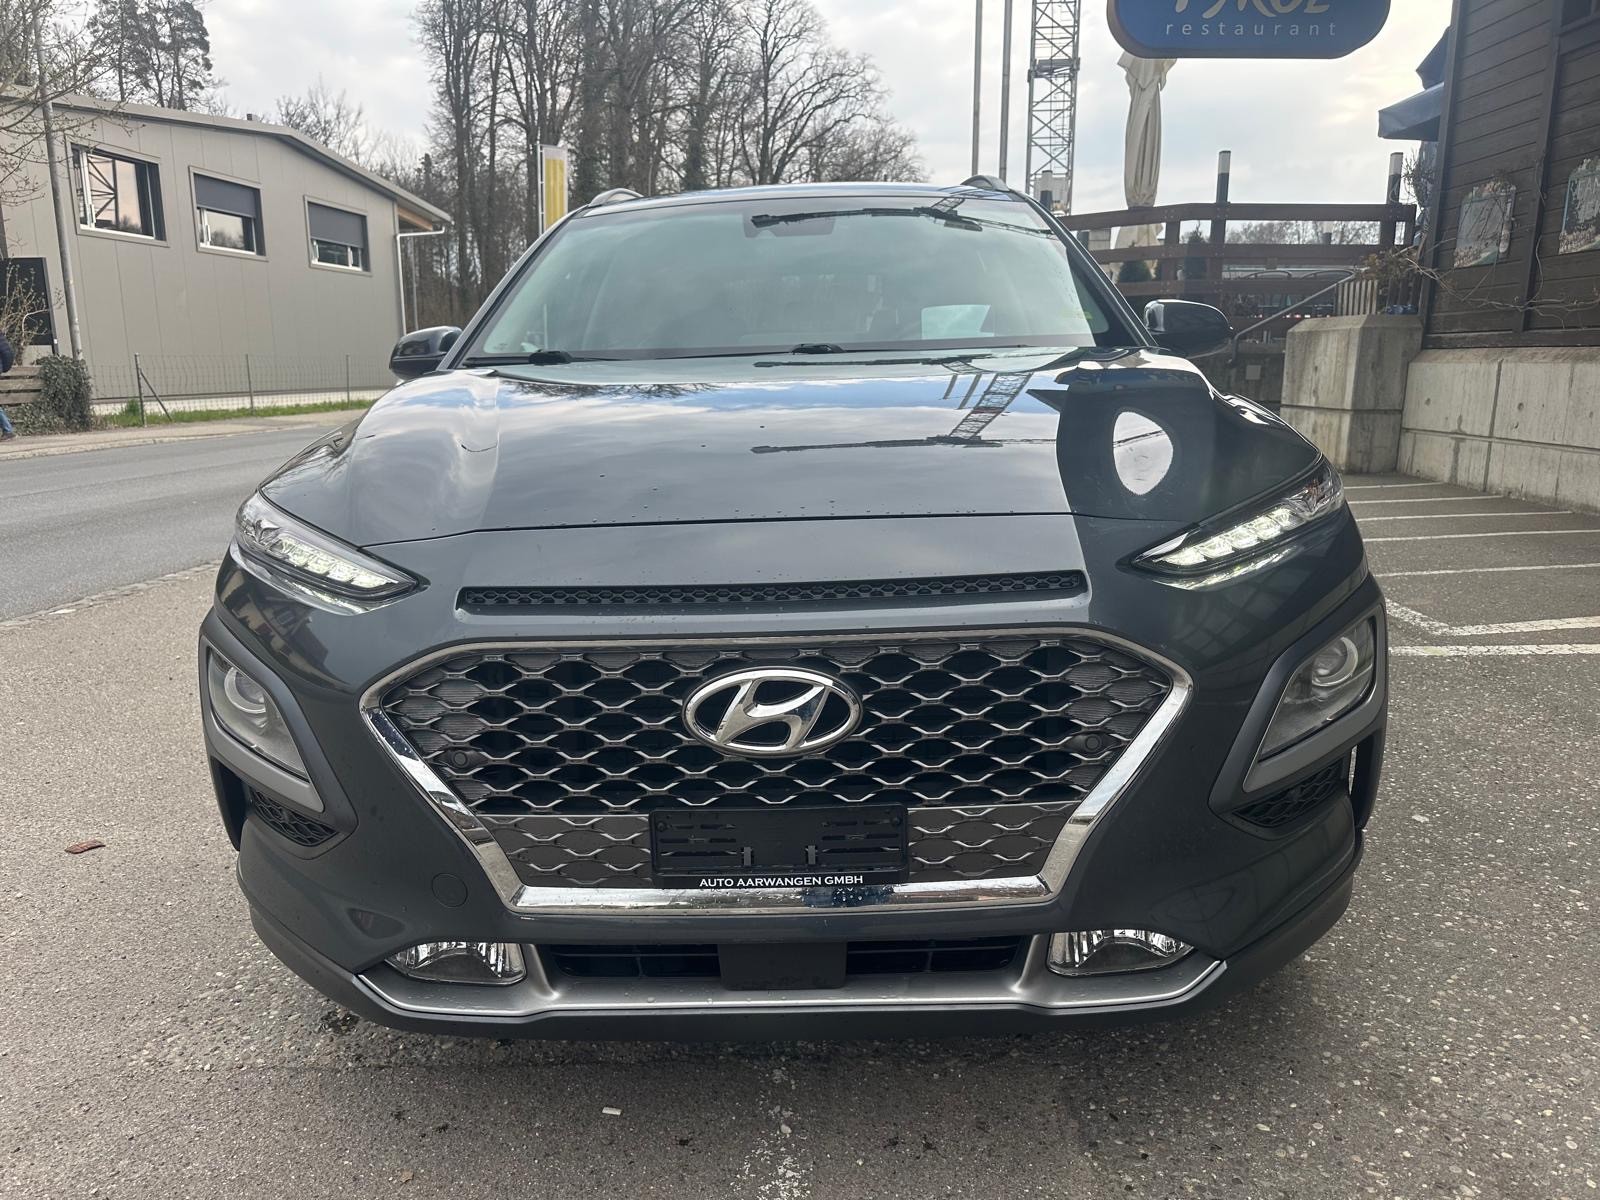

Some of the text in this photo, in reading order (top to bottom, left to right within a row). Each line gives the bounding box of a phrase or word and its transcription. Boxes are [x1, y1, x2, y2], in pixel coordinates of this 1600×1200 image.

[1165, 22, 1336, 36] restaurant
[699, 875, 864, 888] AUTO AARWANGEN GMBH
